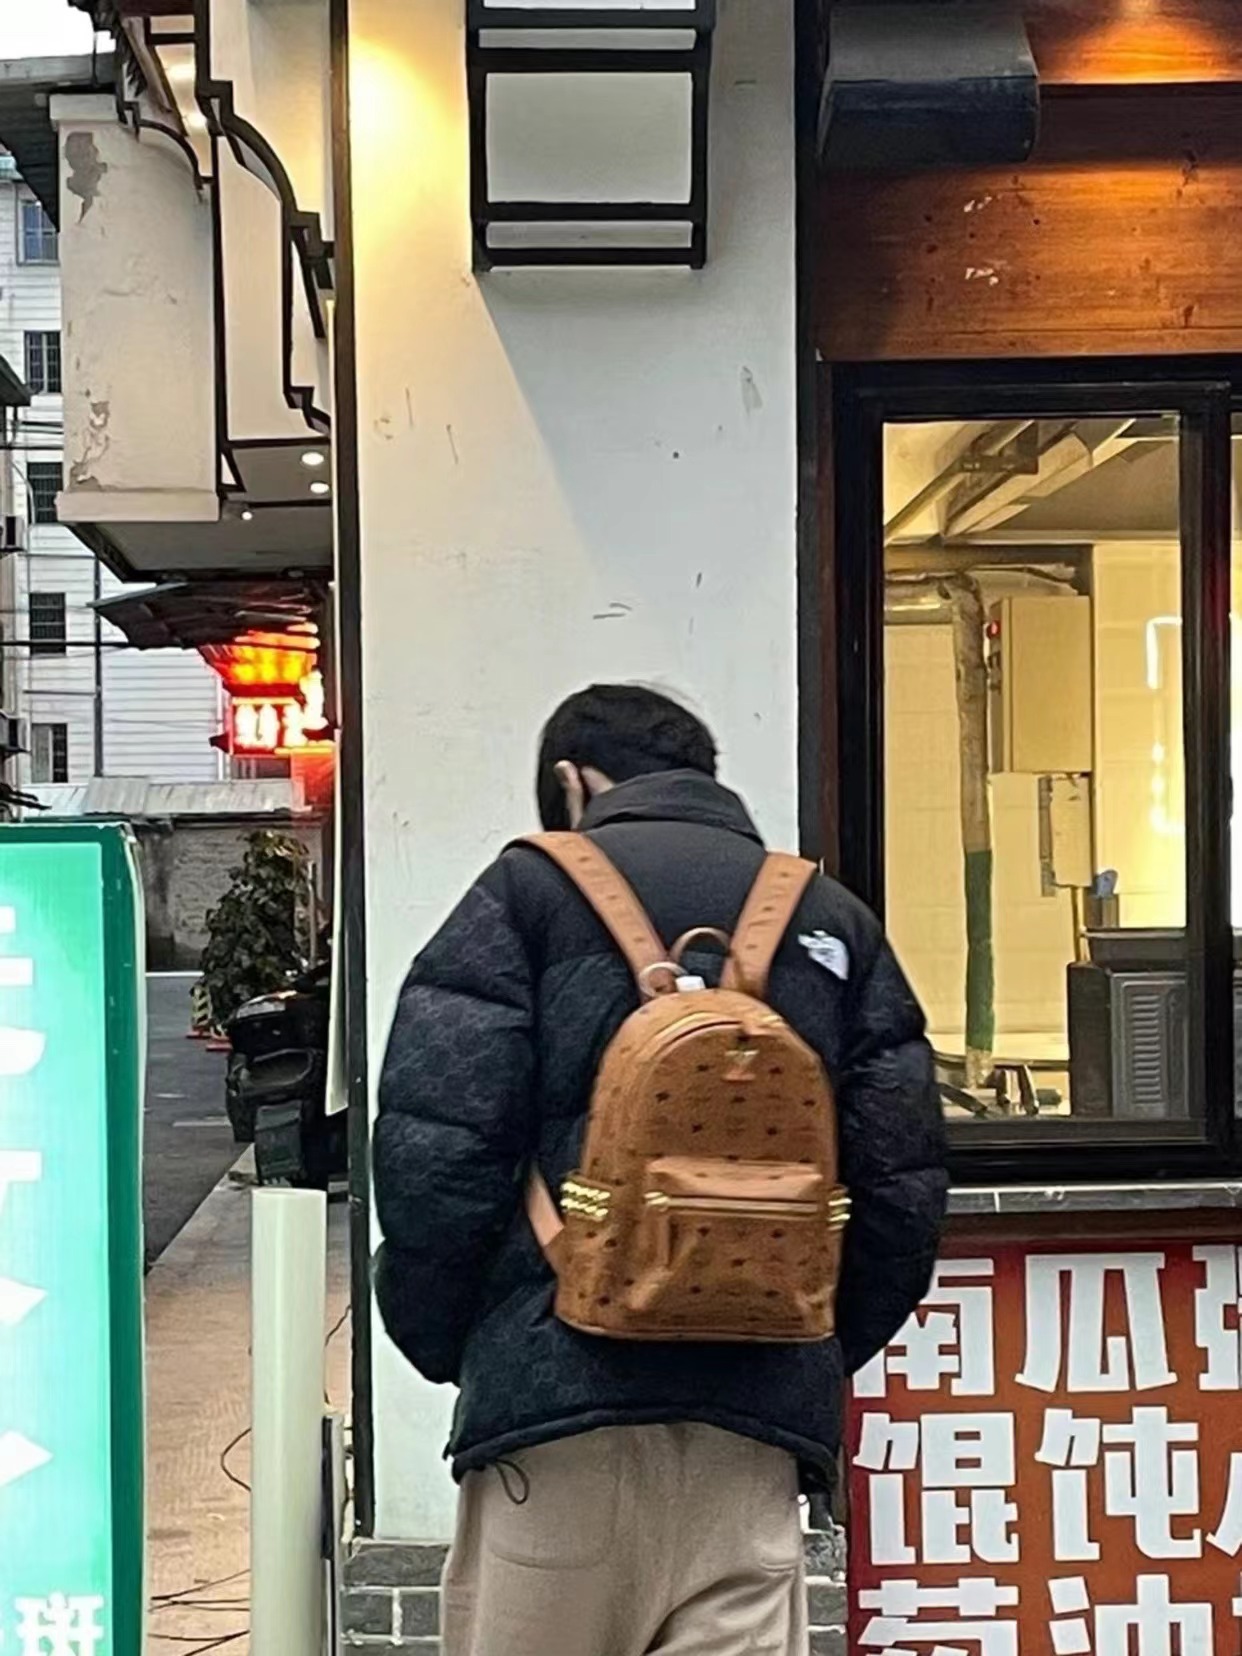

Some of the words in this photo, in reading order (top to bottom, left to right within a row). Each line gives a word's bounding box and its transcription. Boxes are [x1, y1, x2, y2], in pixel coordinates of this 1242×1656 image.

[852, 1245, 1242, 1398] 南瓜
[852, 1405, 1242, 1565] 馄饨
[0, 1591, 104, 1656] 斑
[858, 1574, 1242, 1656] 葱油
